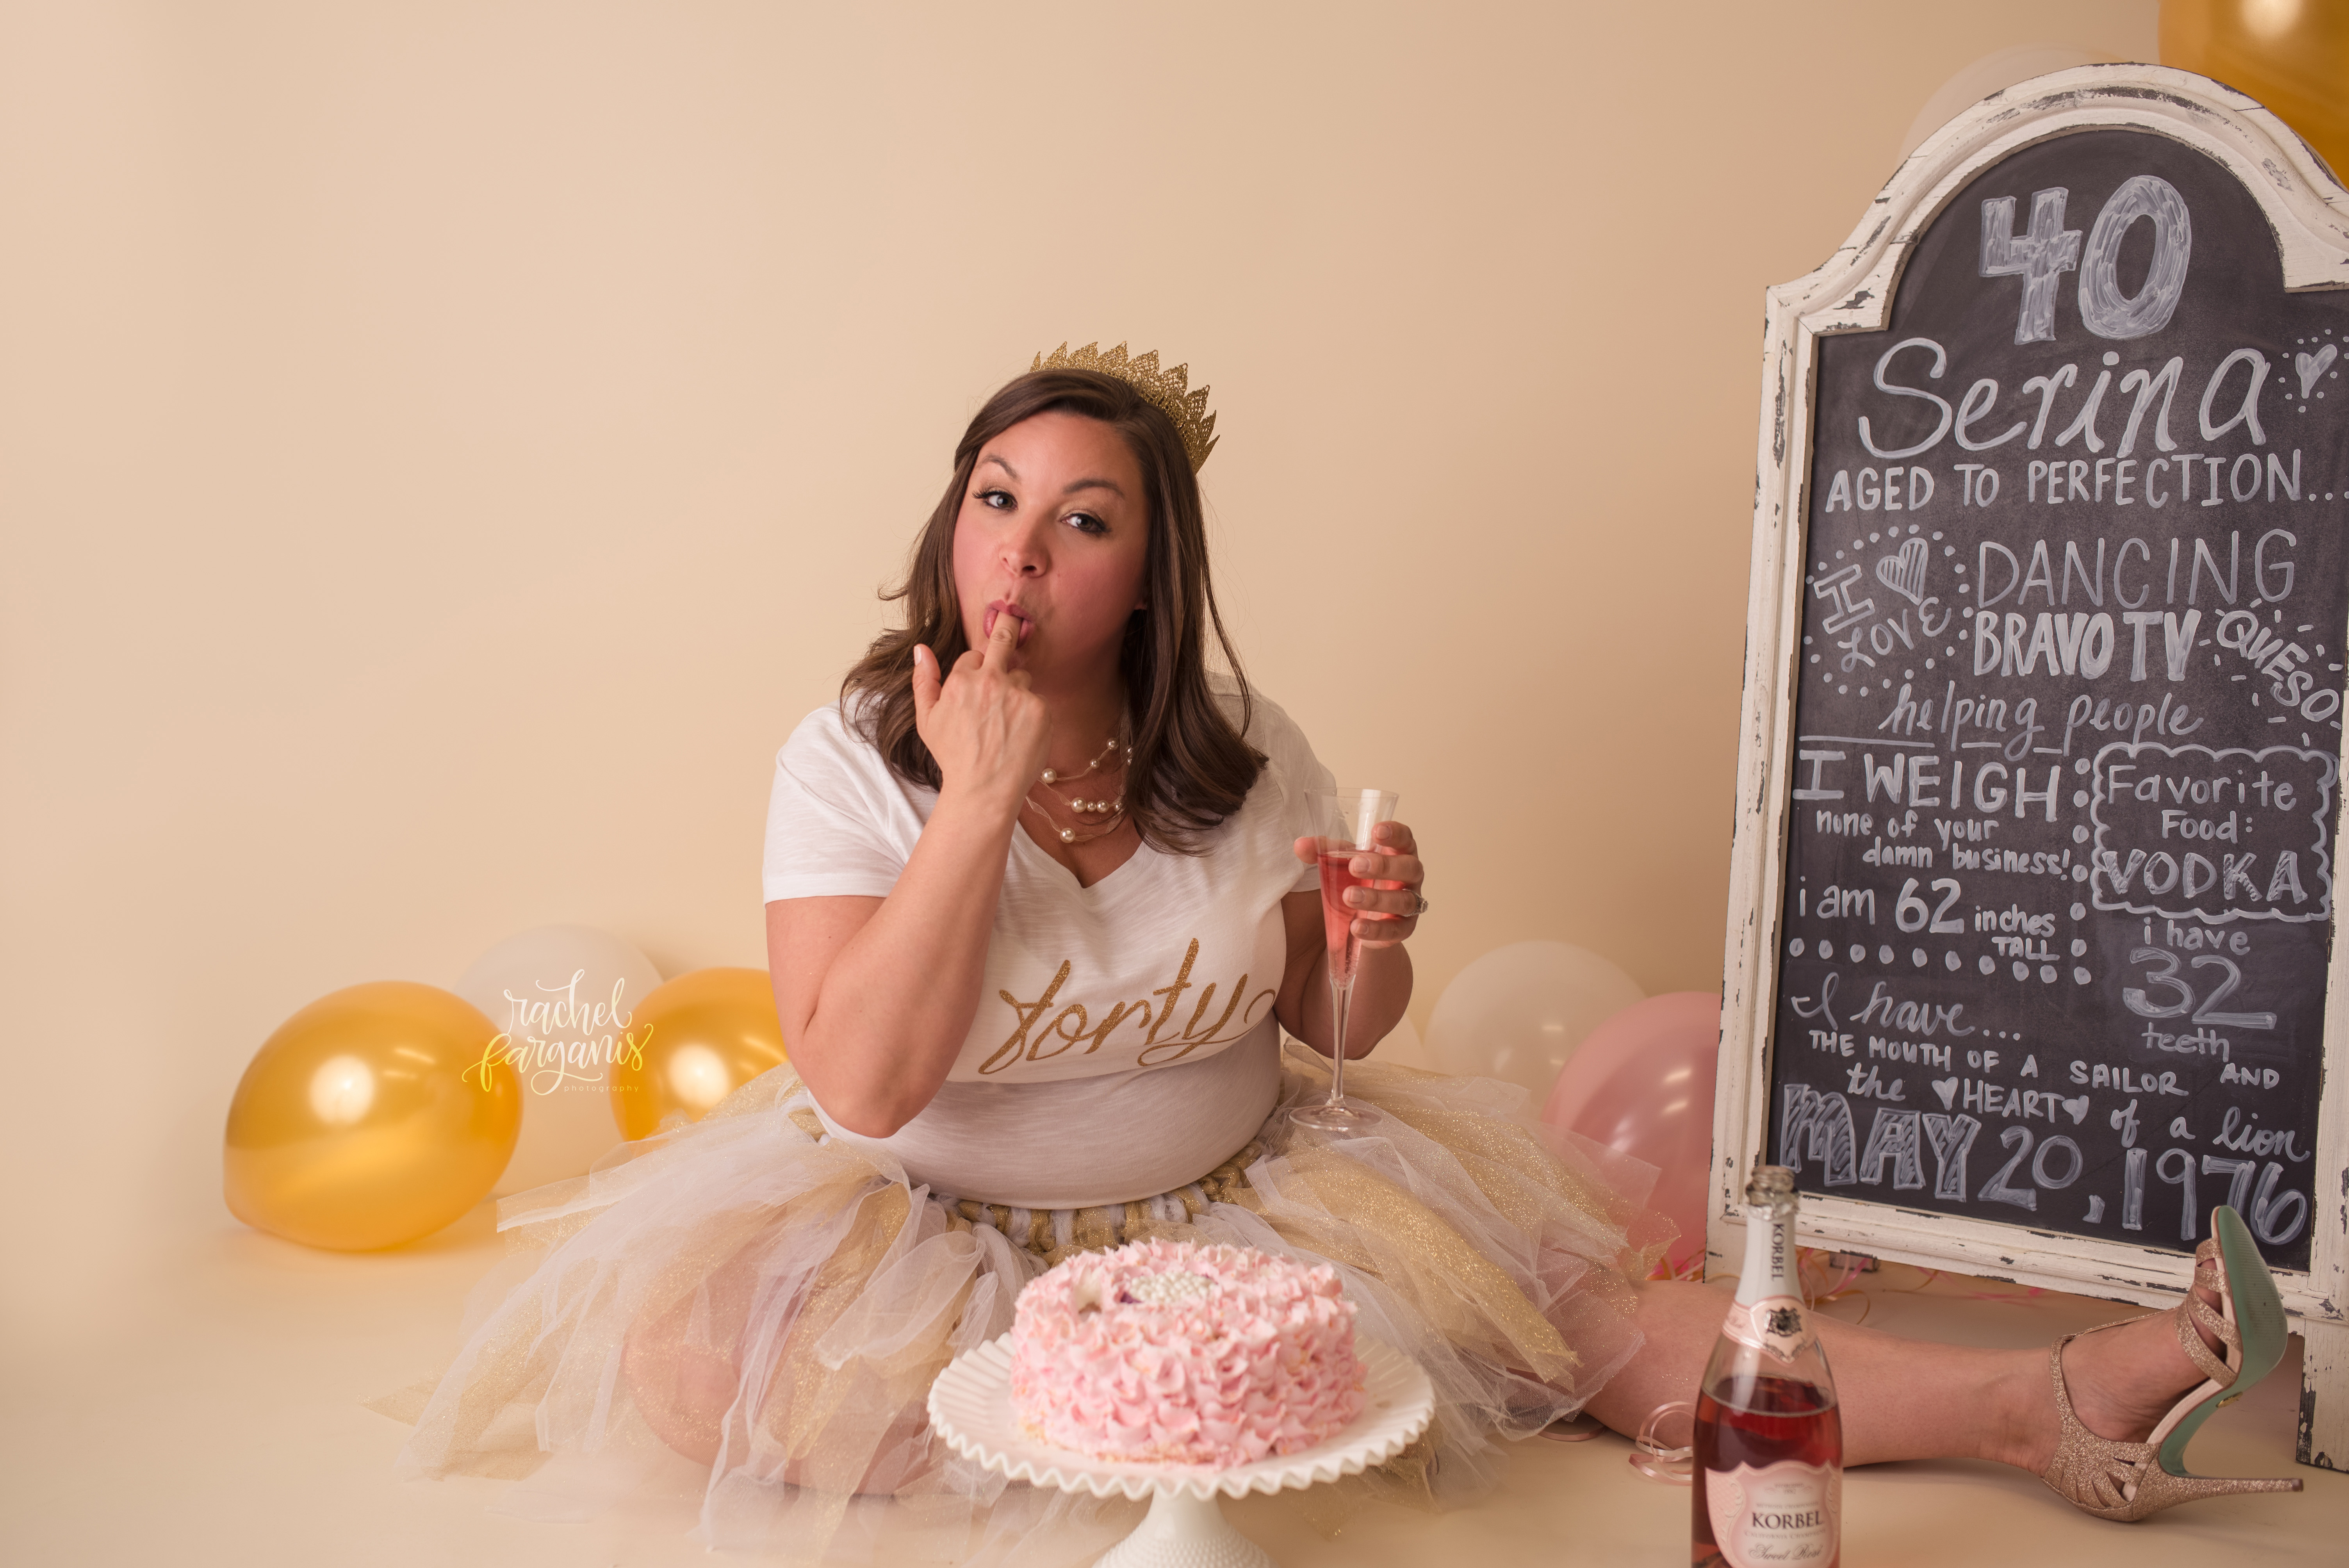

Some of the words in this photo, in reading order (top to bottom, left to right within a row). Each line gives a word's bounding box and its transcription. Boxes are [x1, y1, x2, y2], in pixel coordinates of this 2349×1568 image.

[1980, 175, 2191, 344] 40
[1859, 337, 2271, 459] Serina
[1826, 466, 1935, 512] AGED
[1953, 463, 2000, 507] TO
[1814, 564, 1875, 634] I
[1978, 529, 2296, 609] DANCING
[1837, 597, 1952, 672] LOVE
[2217, 610, 2339, 722] QUESO
[1878, 680, 2044, 761] helping
[2064, 693, 2203, 757] people
[1793, 750, 1846, 800] I
[1864, 753, 2060, 822] WEIGH
[2109, 765, 2297, 811] Favorite
[1816, 810, 1874, 837] none
[1888, 810, 1918, 838] of
[1934, 819, 1999, 851] your
[2162, 810, 2253, 843] Food:
[1862, 836, 1932, 868] damn
[1953, 843, 2070, 880] business!
[2102, 849, 2308, 904] VODKA
[1816, 885, 1875, 925] am
[1895, 878, 1964, 934] 62
[1975, 903, 2055, 937] inches
[2167, 919, 2251, 955] have
[1992, 937, 2060, 961] TALL
[978, 937, 1276, 1075] forty
[2123, 946, 2278, 1030] 32
[1809, 1030, 1855, 1057] THE
[1869, 1036, 1951, 1072] MOUTH
[1968, 1050, 1999, 1073] OF
[2021, 1054, 2038, 1078] A
[2070, 1060, 2189, 1096] SAILOR
[2220, 1063, 2279, 1089] AND
[2141, 1022, 2230, 1062] teeth
[1846, 1062, 1905, 1101] the
[1964, 1078, 2065, 1123] HEART
[2110, 1099, 2140, 1148] of
[2170, 1116, 2196, 1140] a
[2212, 1106, 2311, 1163] lion
[1780, 1083, 1982, 1203] MAY
[2122, 1148, 2308, 1245] 1976
[1771, 1223, 1785, 1282] KORBEL
[1752, 1511, 1823, 1529] KORBEL
[1748, 1543, 1791, 1561] Sweet
